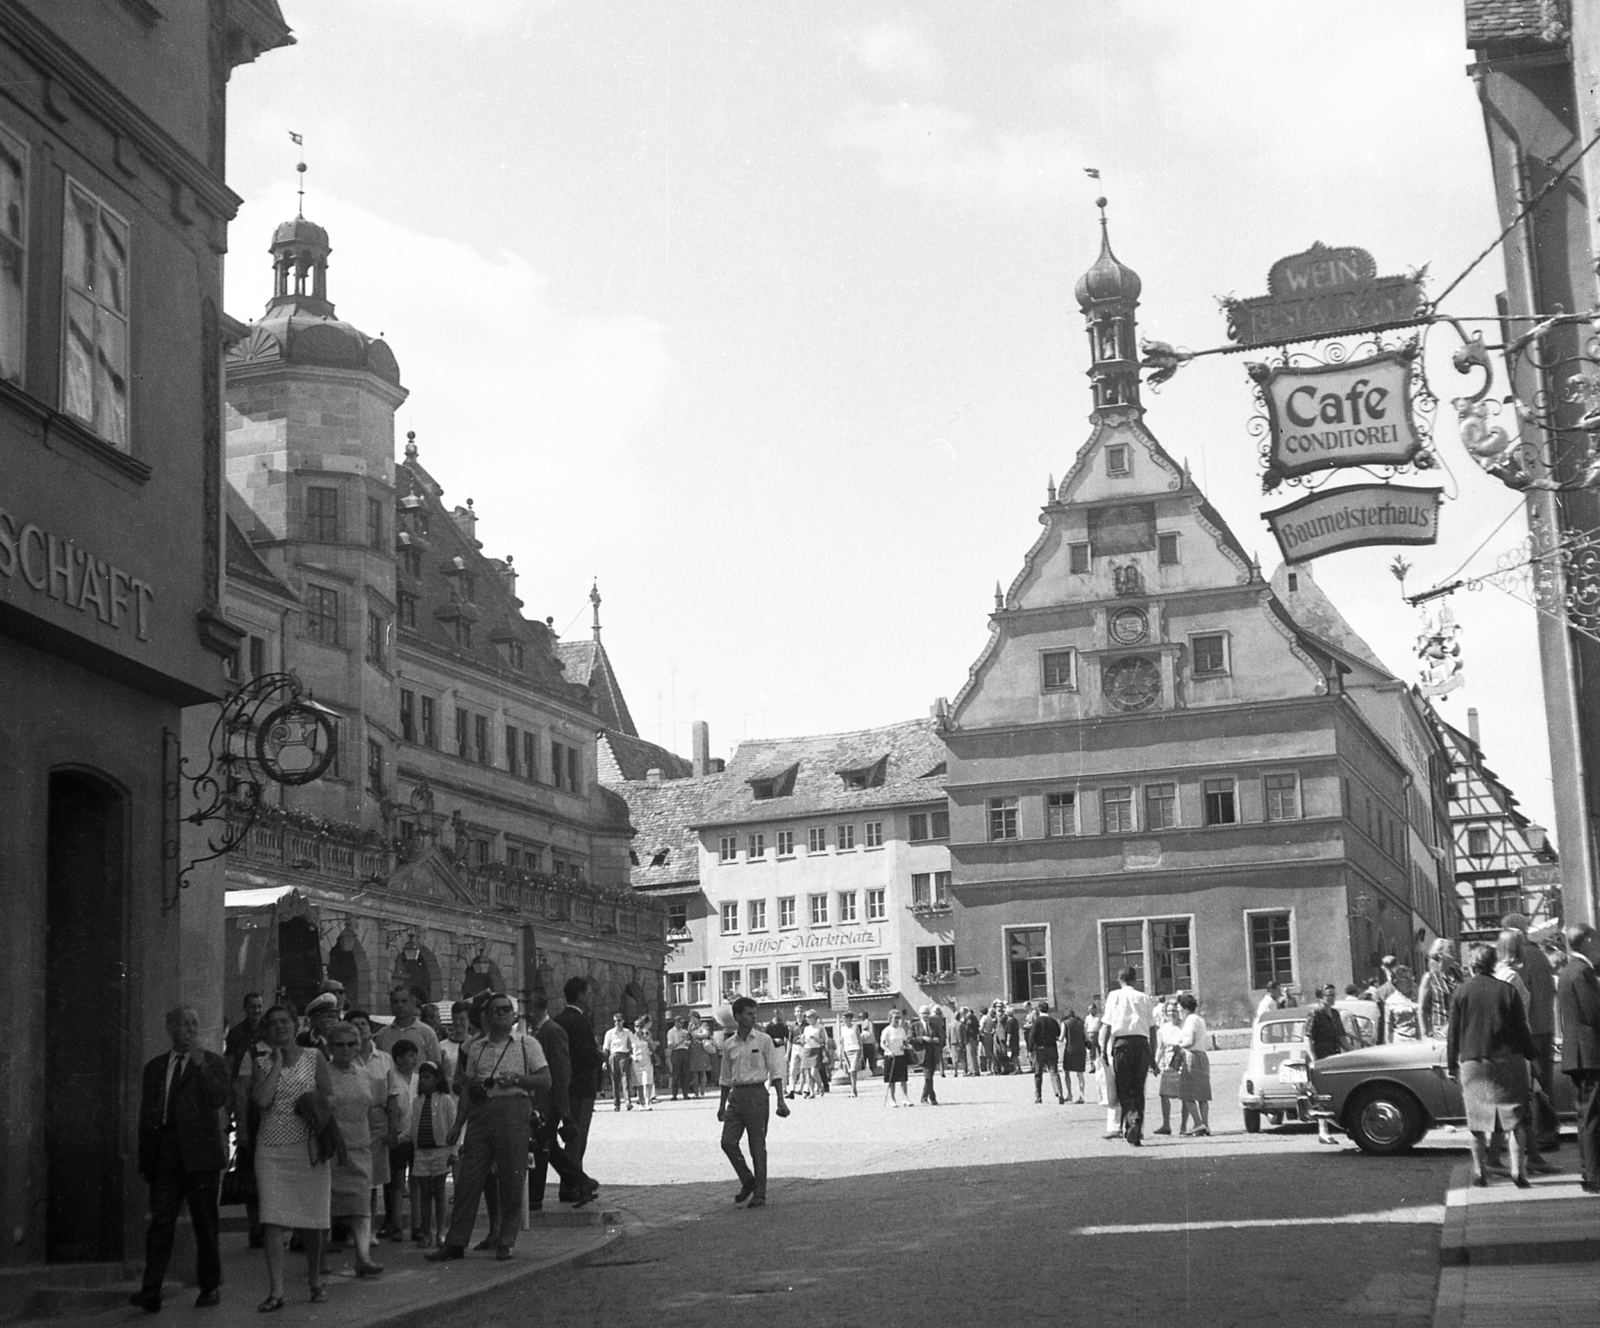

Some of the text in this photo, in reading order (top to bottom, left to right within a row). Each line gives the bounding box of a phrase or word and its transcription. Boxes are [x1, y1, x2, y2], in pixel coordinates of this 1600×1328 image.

[1284, 256, 1359, 292] WEIN
[1285, 378, 1389, 428] Cafe
[1285, 424, 1399, 454] CONDITOREI
[1281, 503, 1429, 549] Baumeisterhaus
[791, 930, 876, 950] Marktplatz
